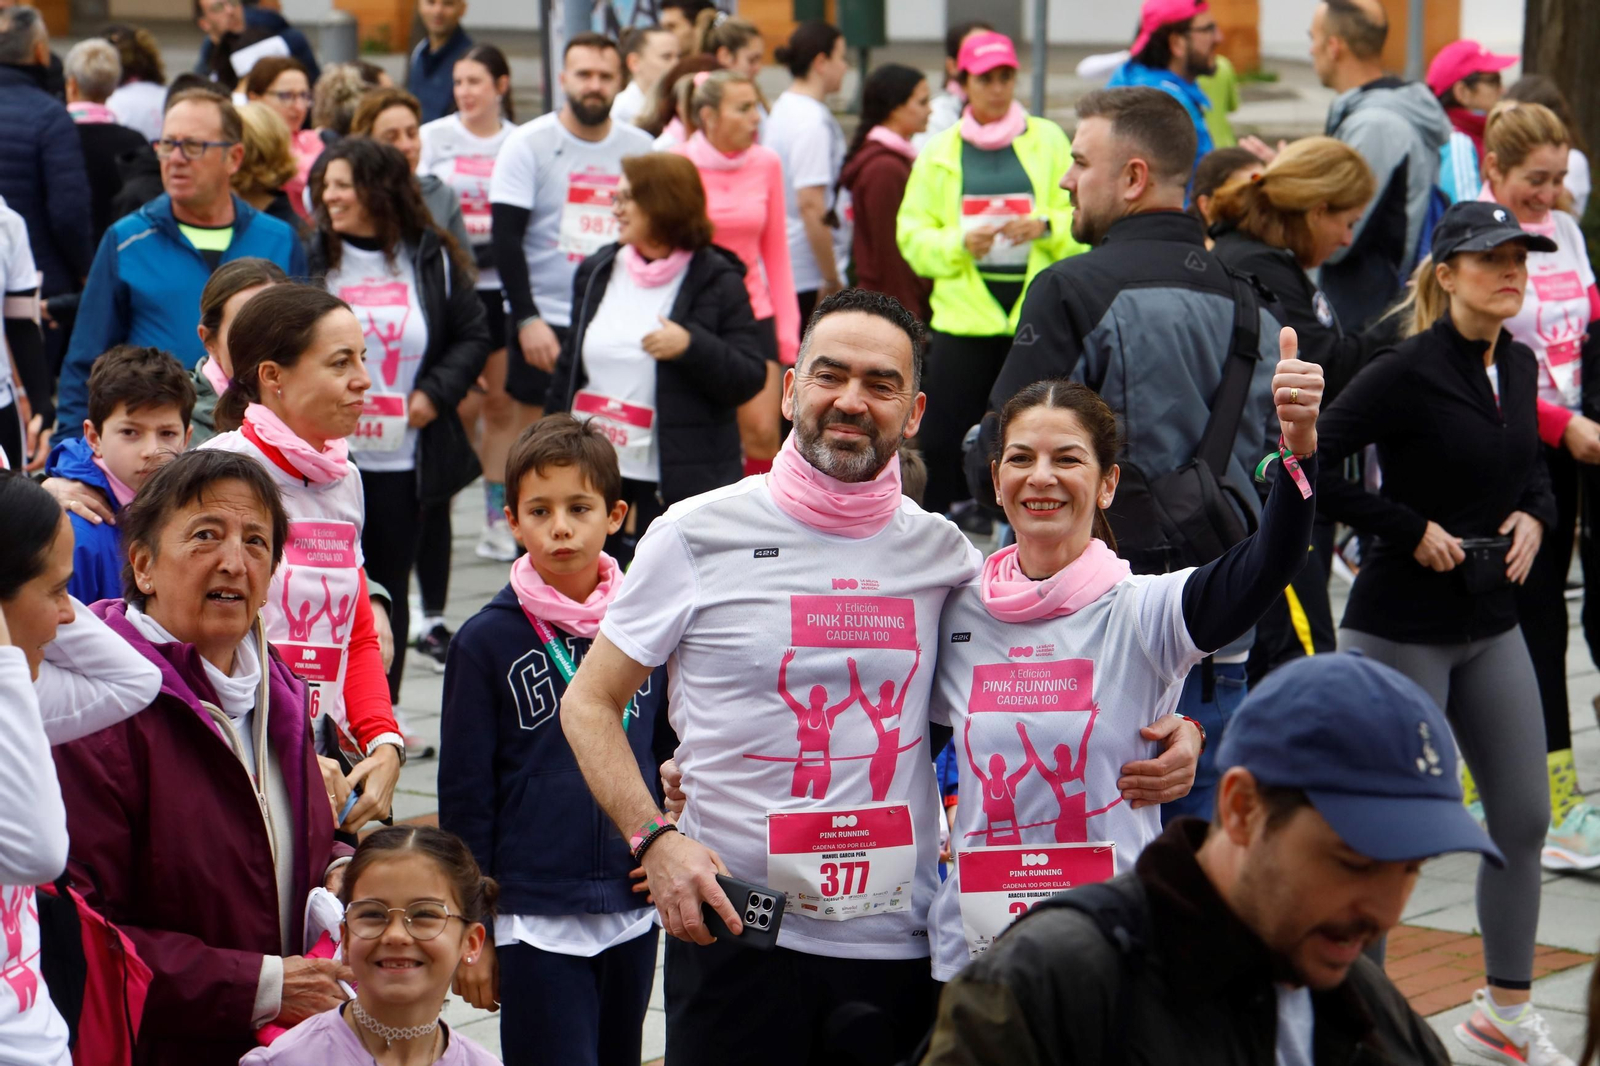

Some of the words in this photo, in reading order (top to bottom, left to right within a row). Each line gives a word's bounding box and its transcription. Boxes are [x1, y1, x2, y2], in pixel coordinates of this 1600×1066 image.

[294, 538, 317, 550] PINK
[318, 539, 350, 552] RUNNING
[307, 552, 333, 562] CADENA
[333, 553, 344, 563] 100
[756, 549, 777, 557] 42K
[832, 578, 858, 590] 100
[836, 602, 842, 613] X
[846, 602, 879, 614] Edición
[807, 614, 840, 627] PINK
[844, 615, 905, 629] RUNNING
[826, 630, 870, 641] CADENA
[872, 631, 890, 642] 100
[1008, 646, 1034, 658] 100
[1010, 669, 1016, 679] X
[1018, 668, 1051, 680] Edición
[982, 680, 1012, 693] PINK
[1015, 678, 1078, 692] RUNNING
[997, 694, 1038, 705] CADENA
[1042, 694, 1059, 705] 100
[832, 814, 858, 828] 100
[820, 831, 838, 839] PINK
[838, 829, 870, 838] RUNNING
[812, 843, 836, 851] CADENA
[1021, 853, 1049, 866] 100
[820, 860, 870, 897] 377
[1009, 870, 1028, 878] PINK
[1028, 868, 1062, 877] RUNNING
[1052, 880, 1070, 888] ELLAS
